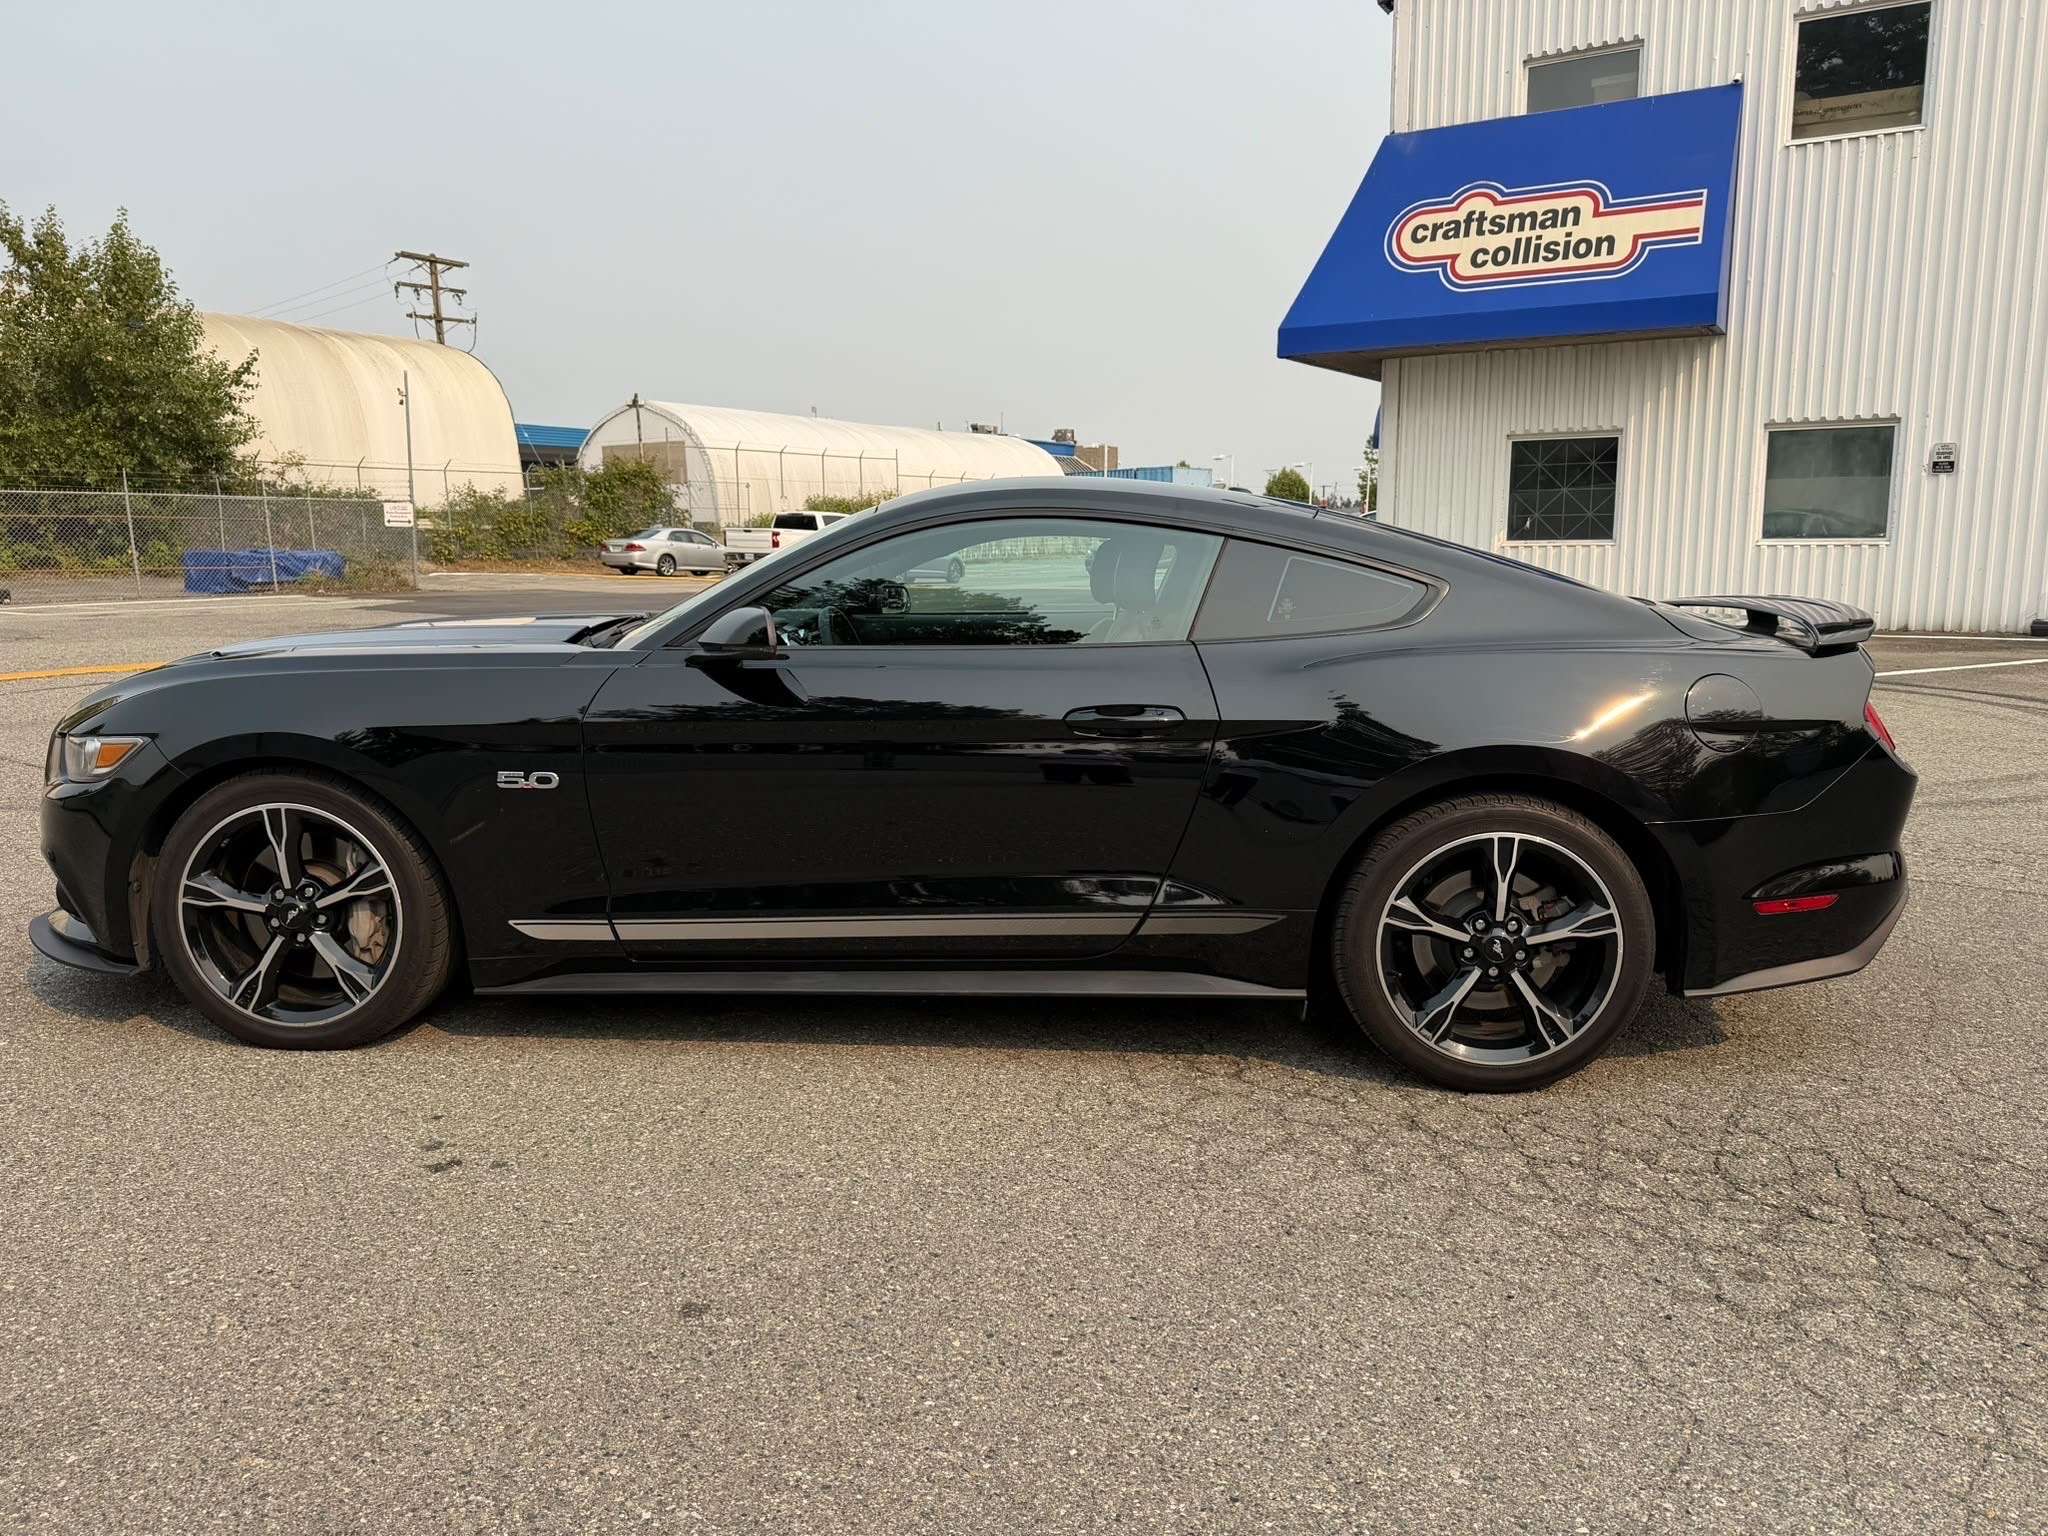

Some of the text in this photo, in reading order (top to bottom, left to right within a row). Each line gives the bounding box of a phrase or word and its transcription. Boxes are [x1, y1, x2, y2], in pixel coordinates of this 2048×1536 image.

[1410, 204, 1582, 244] craftsman
[1469, 231, 1616, 269] collision
[497, 770, 560, 789] 5.0
